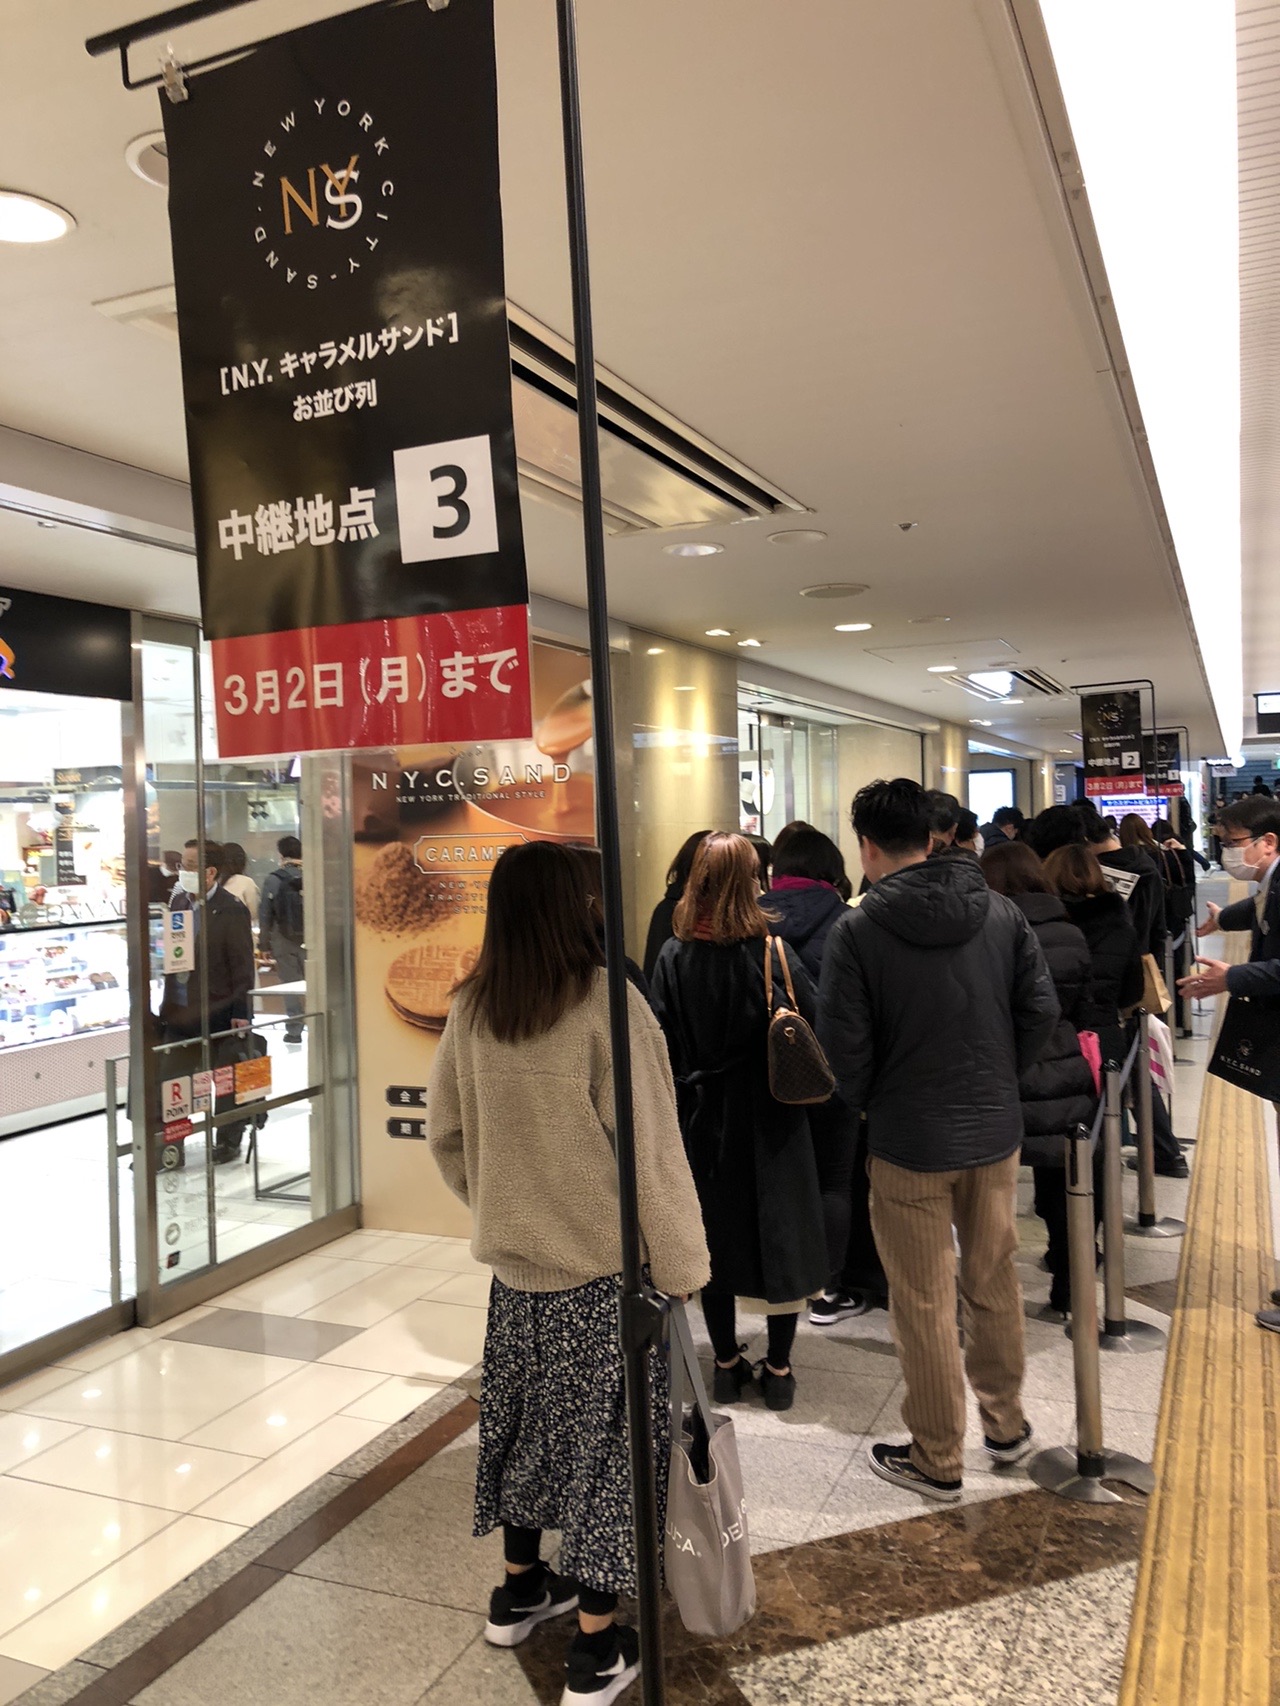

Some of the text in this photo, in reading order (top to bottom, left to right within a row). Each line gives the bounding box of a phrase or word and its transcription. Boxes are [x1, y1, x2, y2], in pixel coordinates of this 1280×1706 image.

[314, 98, 390, 156] YORK
[292, 379, 378, 421] お並び列
[218, 464, 472, 561] 中継地点 3
[1127, 755, 1136, 766] 2
[396, 790, 546, 804] NEW YORK TRADITIONAL STYLE
[425, 845, 507, 862] CARAME
[438, 881, 490, 890] NEW YO
[428, 893, 491, 902] TRADITI
[453, 906, 487, 914] STYL
[171, 1083, 182, 1101] R
